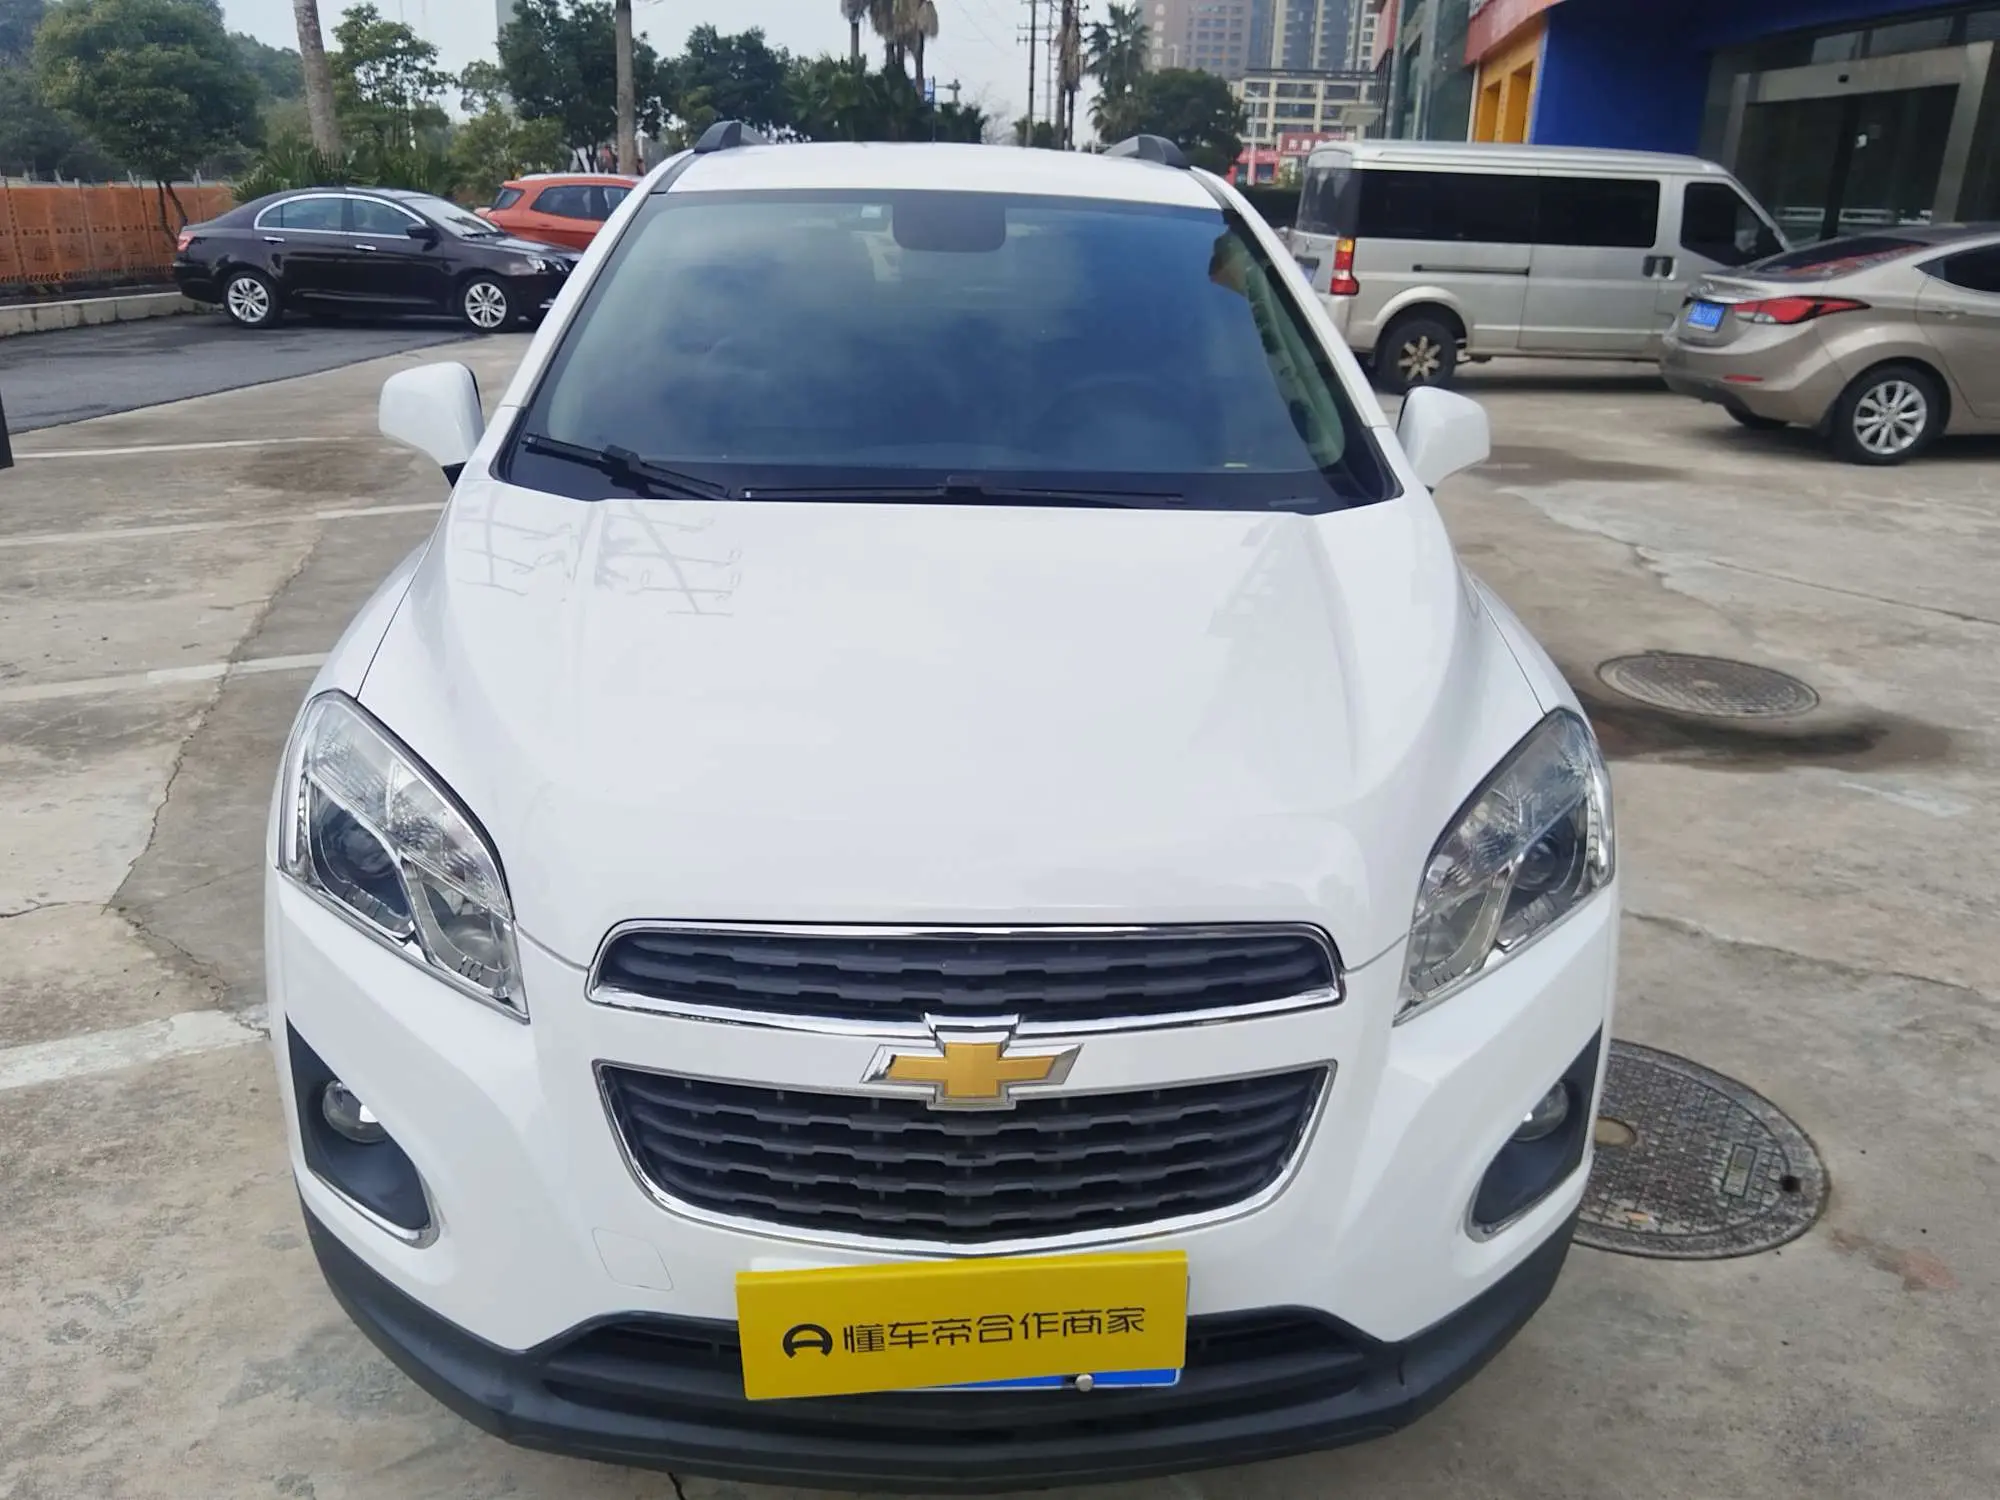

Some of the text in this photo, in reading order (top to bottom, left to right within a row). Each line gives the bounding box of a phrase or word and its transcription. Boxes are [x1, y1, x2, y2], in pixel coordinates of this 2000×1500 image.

[843, 1306, 1146, 1353] 懂车帝合作商家
